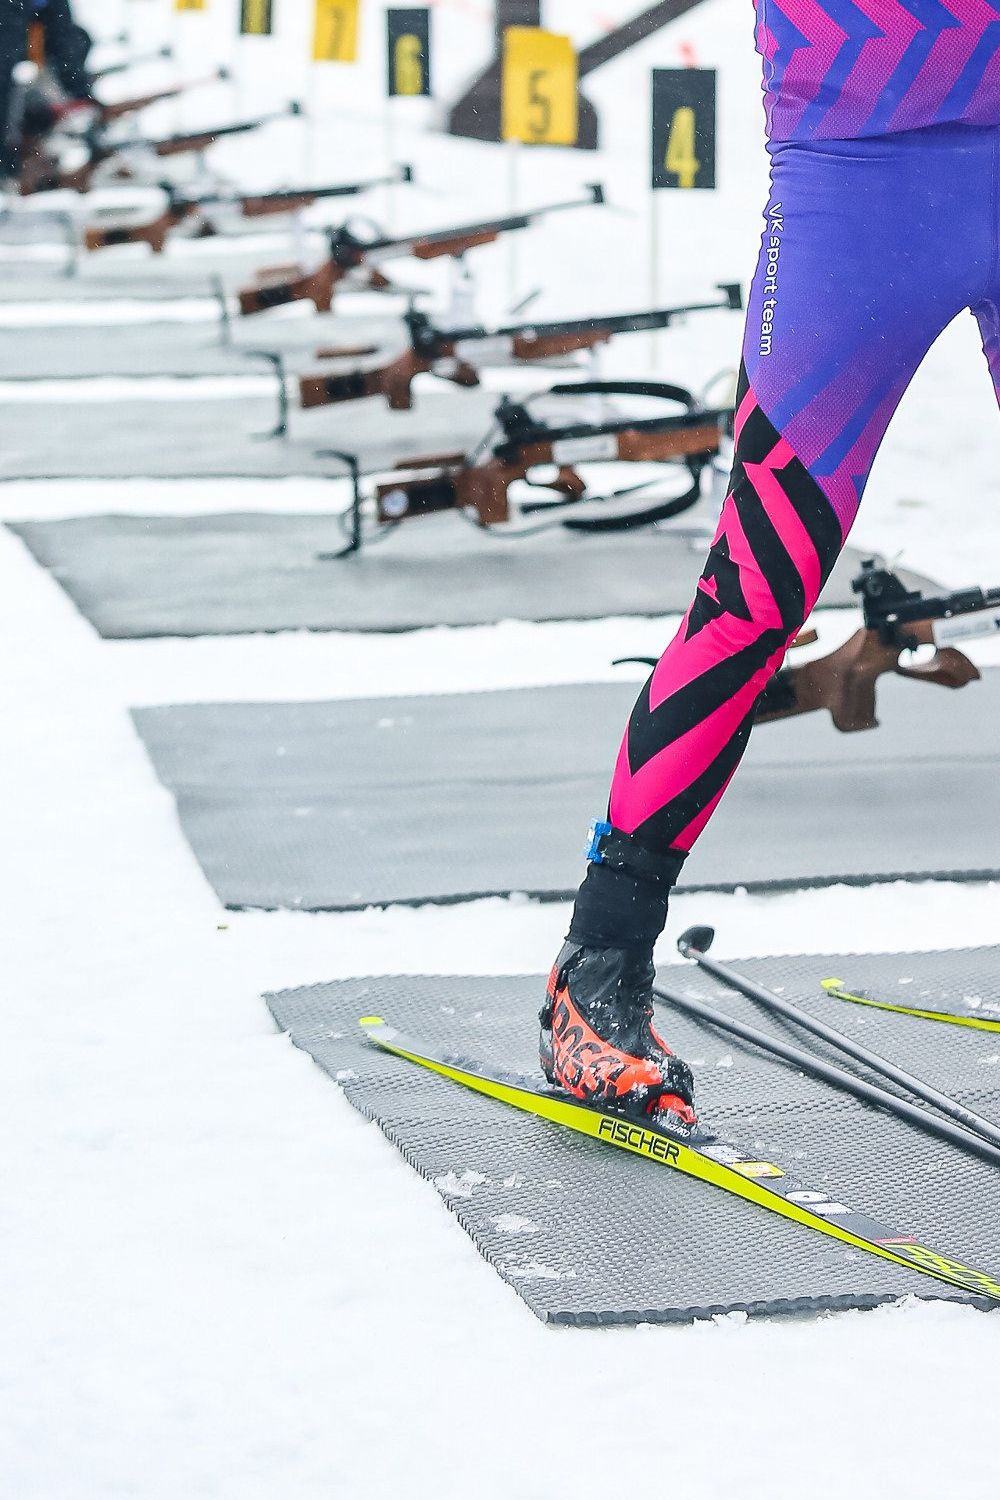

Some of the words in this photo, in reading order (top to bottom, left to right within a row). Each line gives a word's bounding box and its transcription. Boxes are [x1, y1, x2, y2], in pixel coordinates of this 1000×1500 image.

[528, 69, 551, 141] 5
[664, 105, 699, 188] 4
[769, 202, 784, 233] VK
[764, 236, 781, 294] sport
[760, 298, 778, 356] team
[598, 1117, 681, 1165] FISCHER
